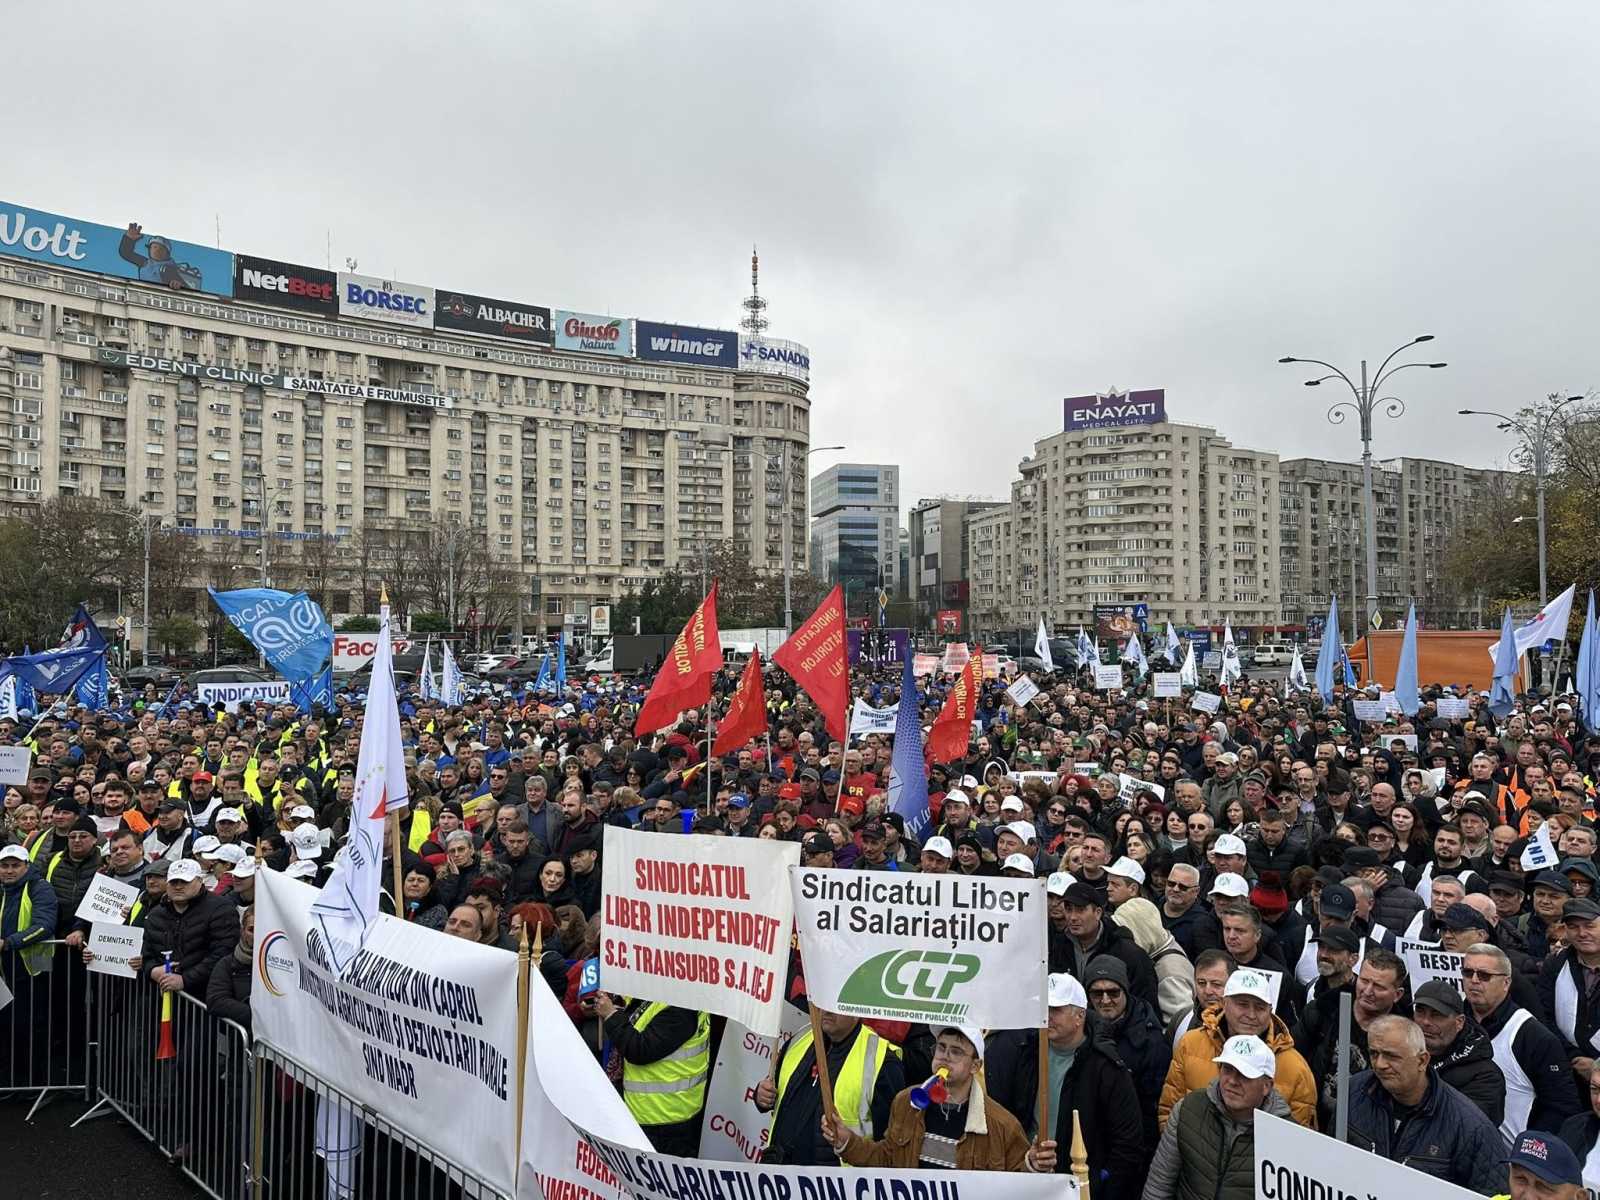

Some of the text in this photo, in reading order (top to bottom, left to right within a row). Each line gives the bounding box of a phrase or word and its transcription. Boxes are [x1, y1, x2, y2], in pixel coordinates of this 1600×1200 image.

[242, 269, 333, 299] NetBet
[347, 283, 427, 315] BORSEC
[477, 304, 547, 330] ALBACHER
[565, 318, 620, 341] Giusto
[579, 339, 616, 350] Natura
[651, 332, 724, 357] winner
[126, 354, 275, 386] EDENT CLINIC
[758, 346, 810, 370] SANADOR
[367, 387, 374, 398] E
[1073, 402, 1156, 421] ENAYATI
[1082, 420, 1120, 428] MEDICAL
[635, 858, 750, 900] SINDICATUL
[93, 893, 125, 910] COLECTIVE
[98, 886, 128, 901] NEGOCIERI
[802, 873, 1030, 912] Sindicatul Liber
[91, 902, 111, 915] REALE
[605, 894, 652, 934] LIBER
[816, 905, 1009, 948] al Salariaților
[92, 953, 102, 961] NU
[605, 938, 630, 969] S.C.
[633, 944, 720, 985] TRANSURB
[883, 950, 981, 999] CTP
[410, 970, 432, 1013] DIN
[432, 977, 483, 1026] CADRUL
[837, 1004, 871, 1016] COMPANIA
[873, 1008, 882, 1016] DE
[883, 1009, 923, 1020] TRANSPORT
[925, 1013, 949, 1022] PUBLIC
[335, 987, 394, 1046] AGRICULTURII
[478, 1039, 508, 1101] RURALE
[362, 1042, 418, 1099] SIND MADR
